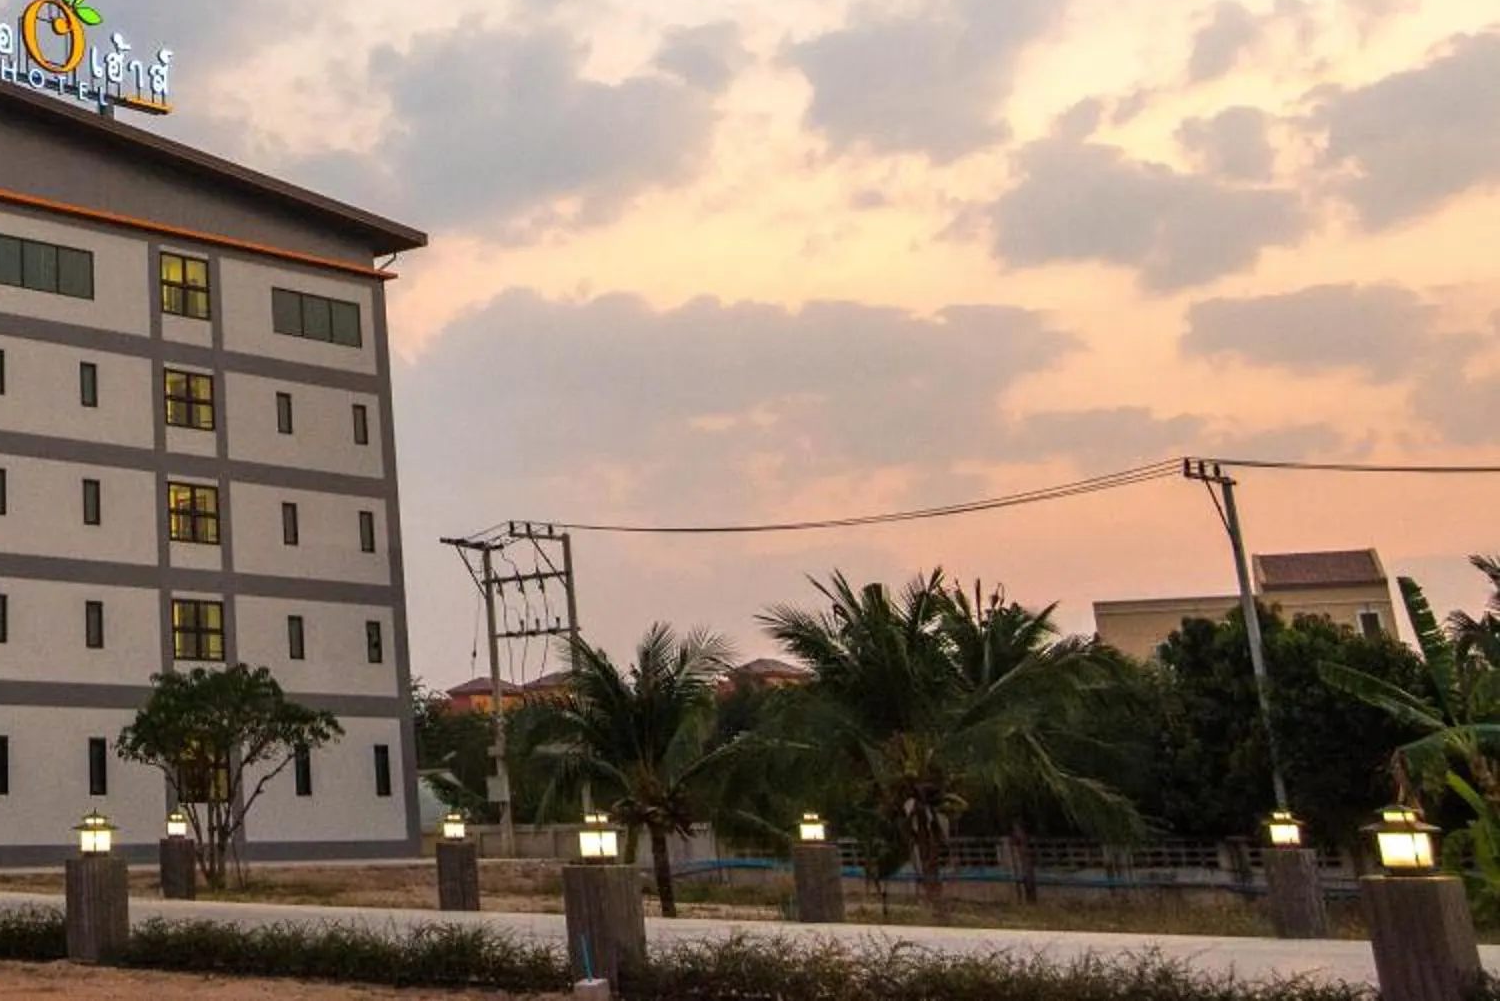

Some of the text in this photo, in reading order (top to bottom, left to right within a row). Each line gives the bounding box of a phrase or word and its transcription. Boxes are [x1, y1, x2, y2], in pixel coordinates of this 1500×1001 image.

[1, 57, 108, 106] HOTEL
[89, 32, 174, 95] เฮ้าส์
